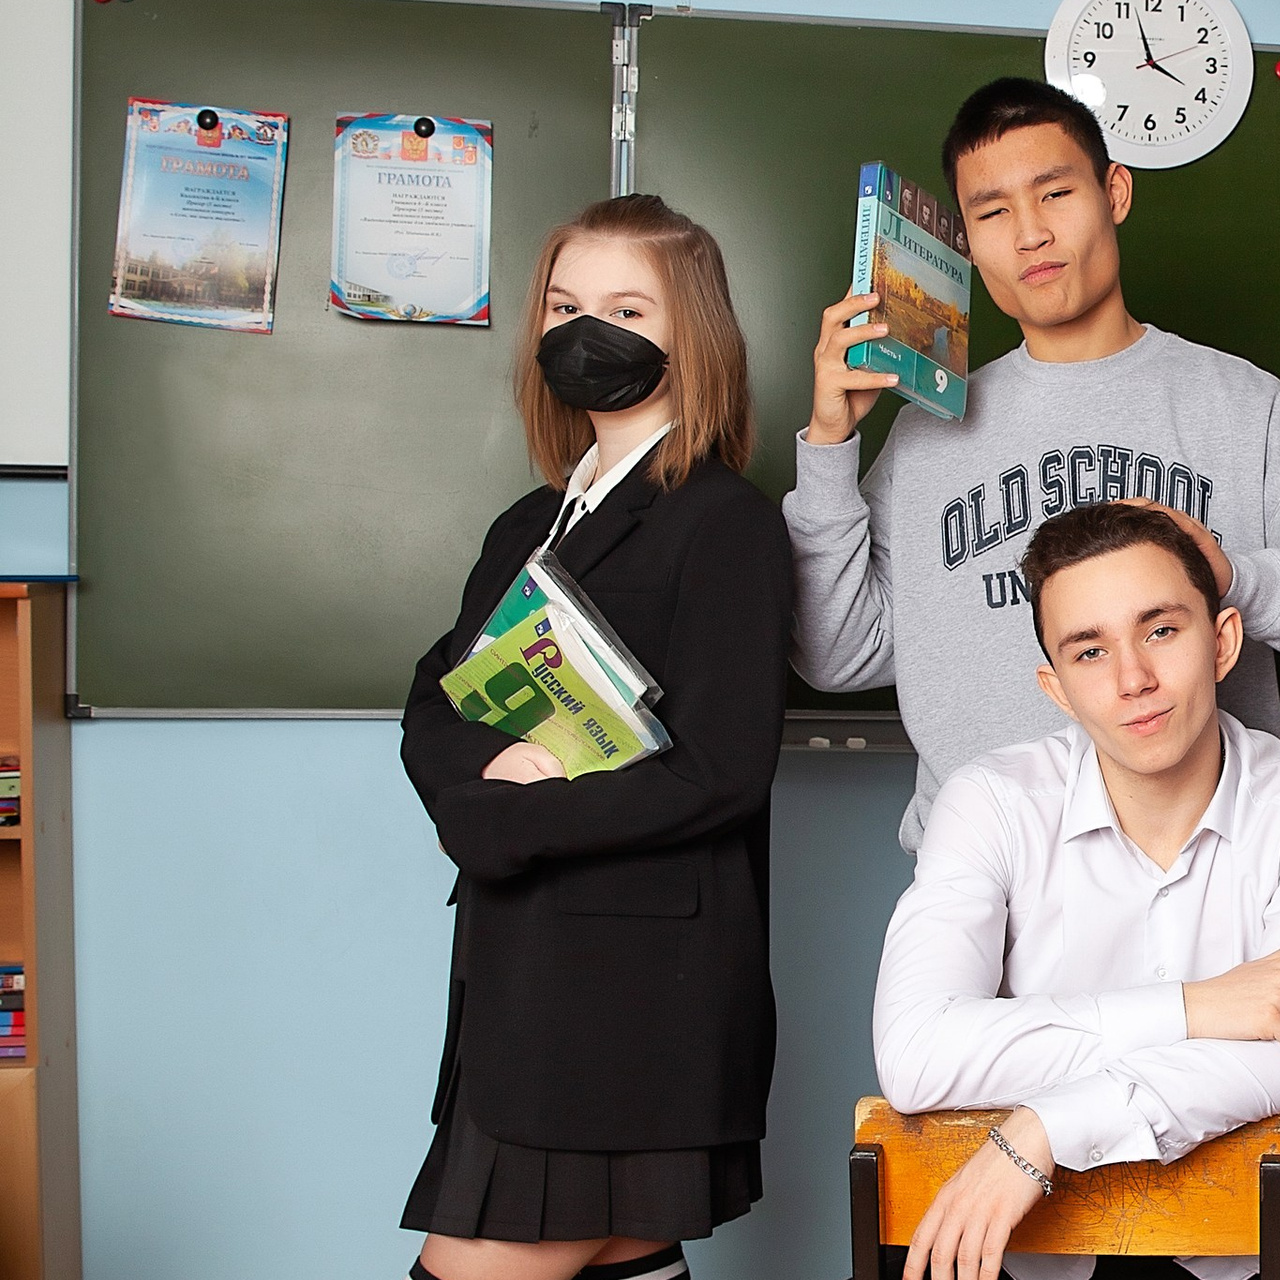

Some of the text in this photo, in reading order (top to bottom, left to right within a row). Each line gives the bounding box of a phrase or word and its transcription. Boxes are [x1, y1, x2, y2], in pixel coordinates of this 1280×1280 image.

[1115, 2, 1130, 19] 11
[1178, 5, 1184, 22] 1
[1094, 22, 1114, 39] 10
[1197, 27, 1209, 44] 2
[1083, 51, 1096, 68] 9
[1205, 57, 1217, 74] 3
[1194, 87, 1207, 104] 4
[1117, 105, 1129, 121] 7
[1144, 113, 1156, 130] 6
[1174, 107, 1187, 124] 5
[160, 156, 250, 182] ГРАМОТА
[377, 171, 452, 188] ГРАМОТА
[857, 204, 872, 284] ЛИТЕРАТУРА
[883, 209, 965, 285] ЛИТЕРАТУРА
[878, 343, 898, 360] Часть
[934, 368, 949, 394] 9
[941, 464, 1032, 571] OLD
